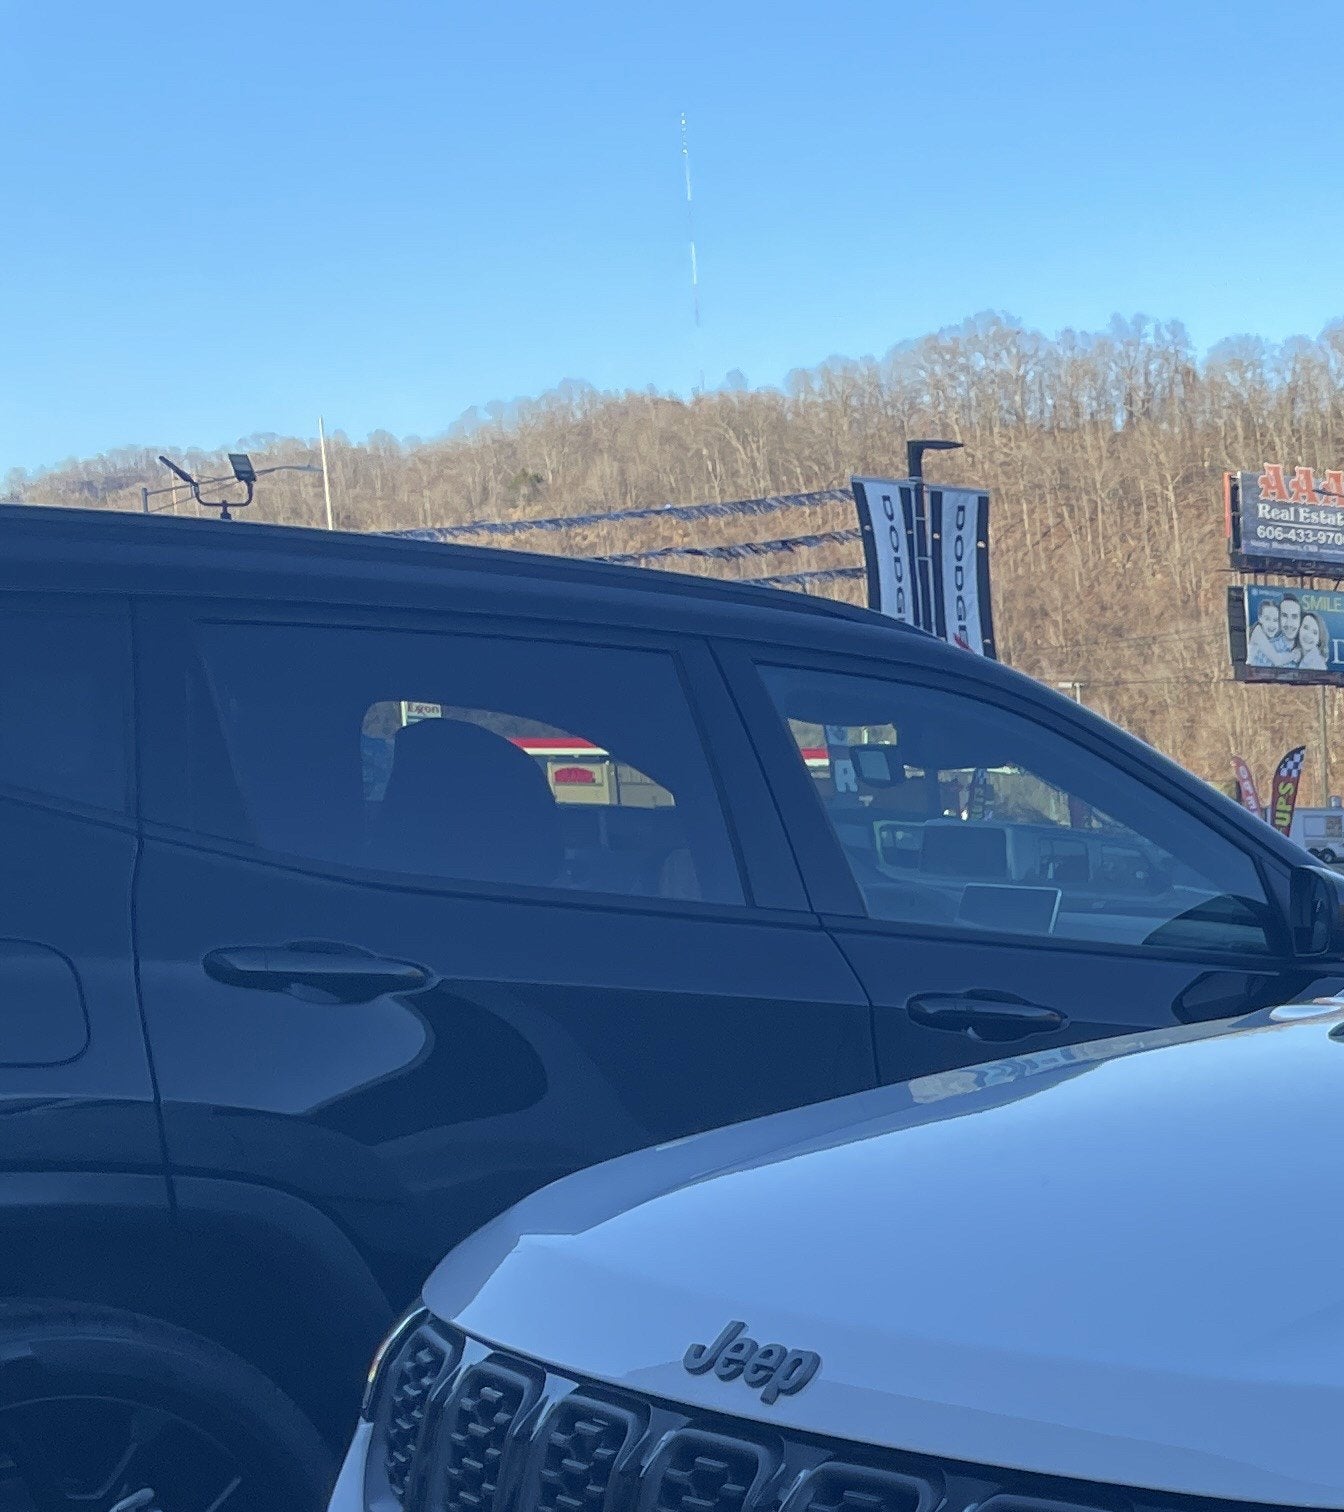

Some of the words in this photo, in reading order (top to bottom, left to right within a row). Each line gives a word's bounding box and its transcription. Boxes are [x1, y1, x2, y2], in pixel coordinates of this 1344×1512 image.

[882, 495, 905, 621] DODG
[1257, 503, 1295, 522] Real
[955, 505, 968, 644] DODGE
[683, 1320, 821, 1406] Jeep
